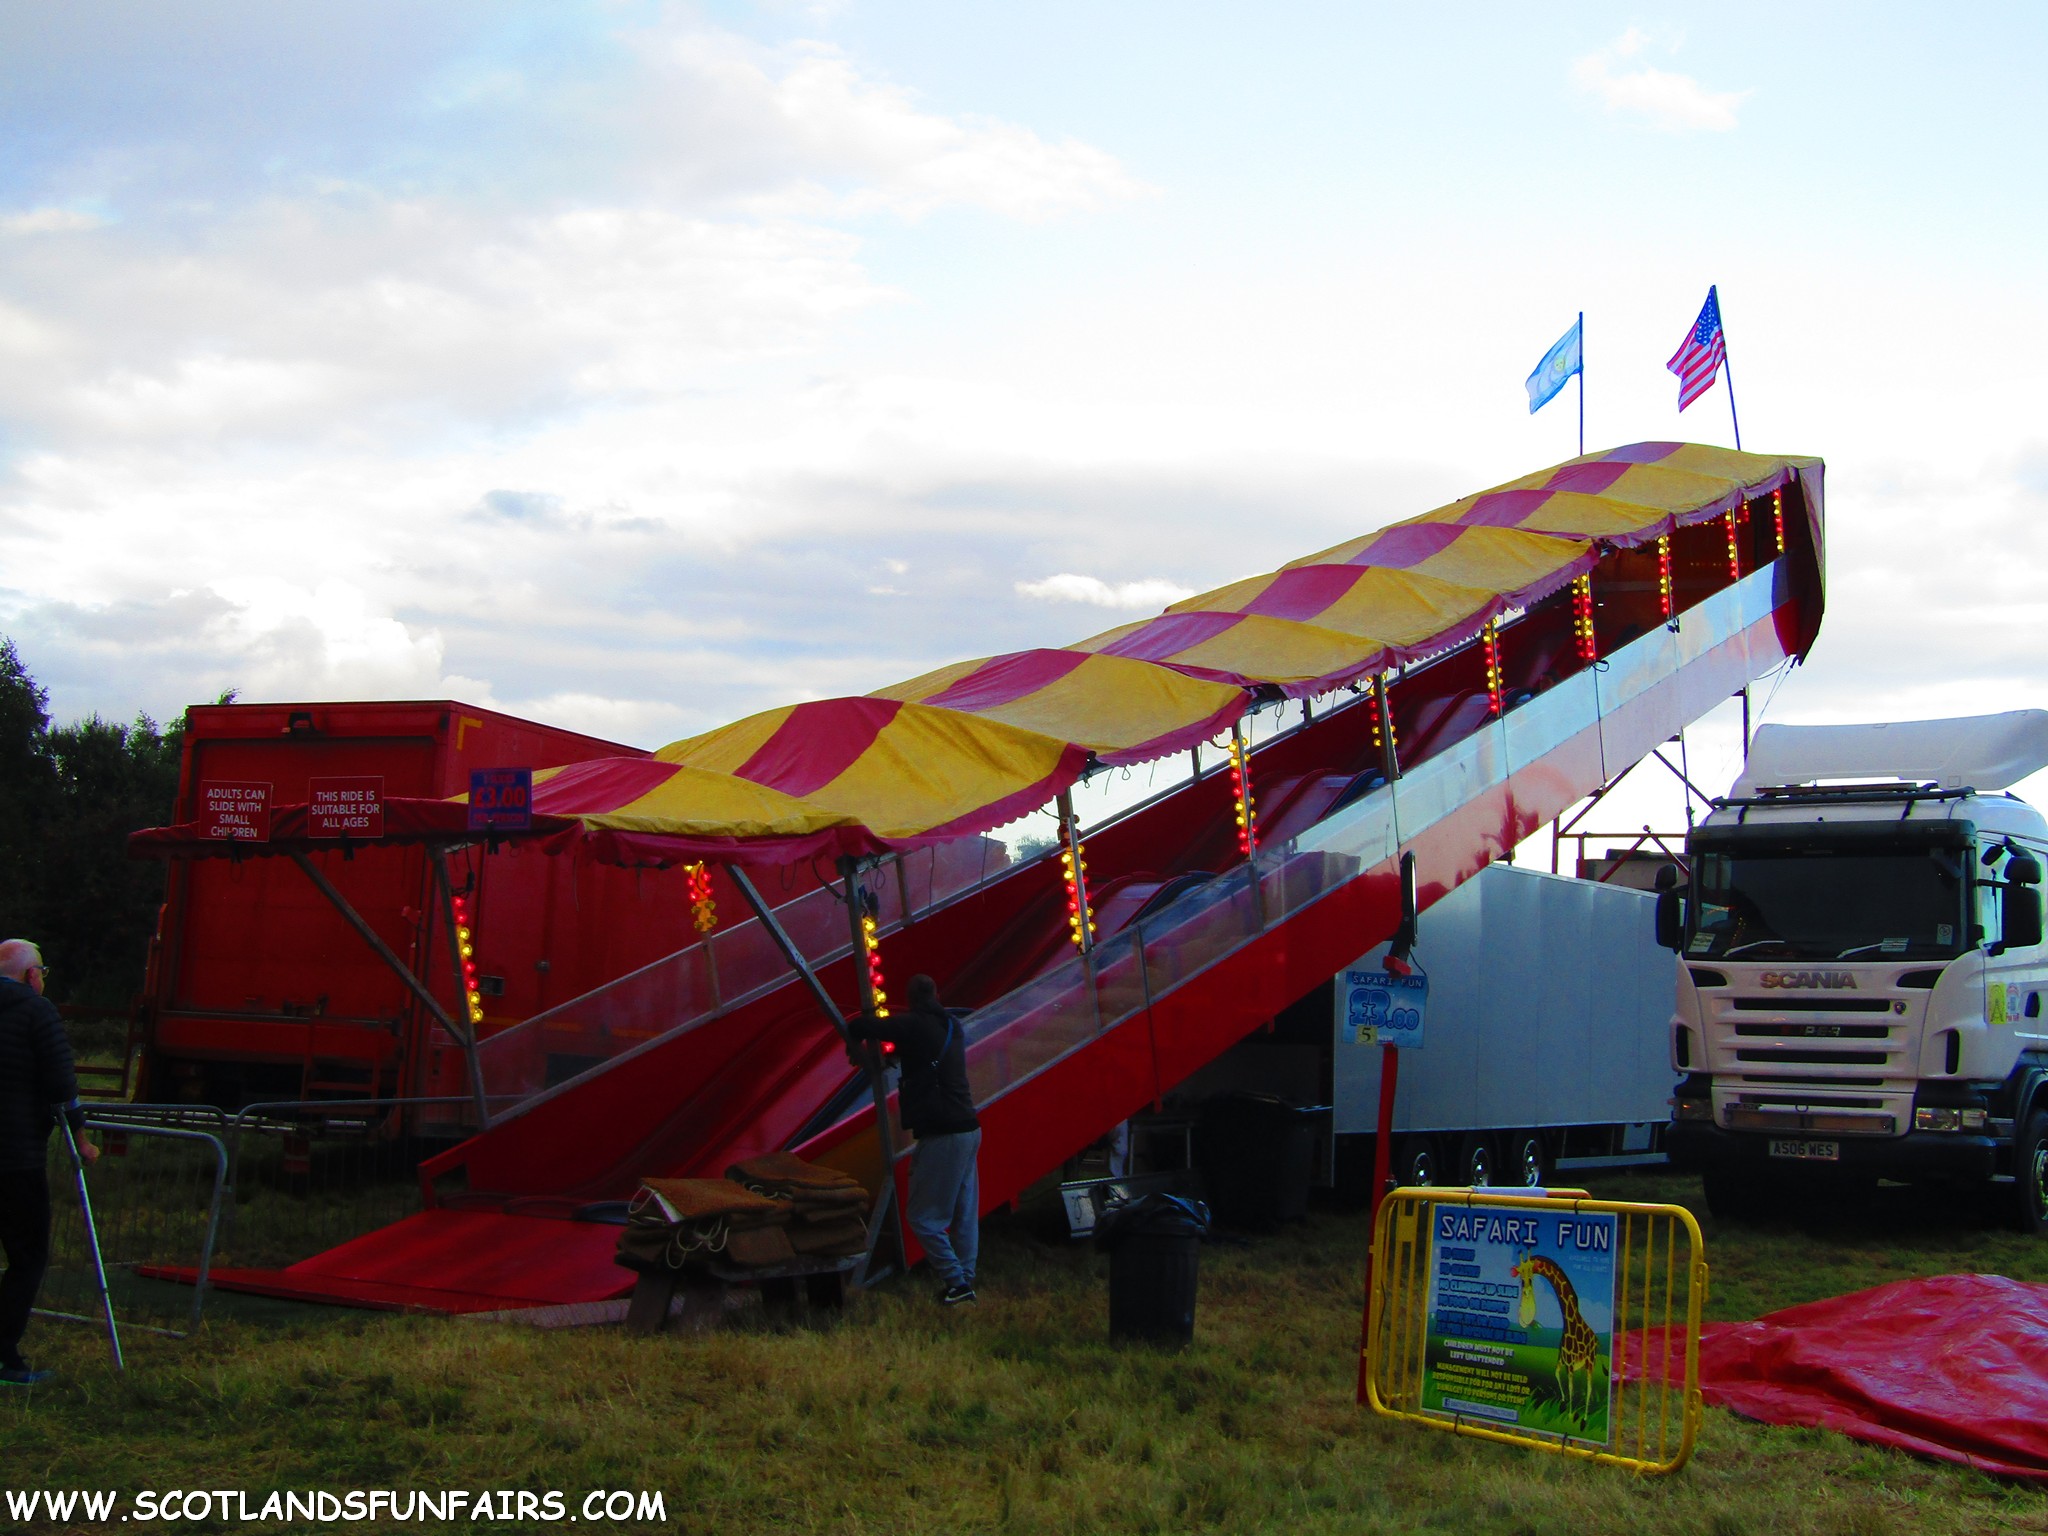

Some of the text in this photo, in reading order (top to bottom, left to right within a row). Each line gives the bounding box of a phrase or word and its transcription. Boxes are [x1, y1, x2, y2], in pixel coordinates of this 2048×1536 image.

[207, 788, 264, 800] ADULTS CAN
[317, 791, 374, 801] THIS RIDE IS
[474, 786, 526, 808] £3.00
[209, 801, 261, 812] SLIDE WITH
[312, 804, 379, 815] SUITABLE FOR
[220, 814, 250, 825] SMALL
[323, 817, 369, 828] ALL AGES
[1353, 976, 1422, 987] SAFARI FUN
[1760, 972, 1857, 989] SCANIA
[1349, 988, 1419, 1030] £3.00
[1362, 1028, 1371, 1042] 5
[1774, 1142, 1833, 1156] AS06 WES
[1441, 1215, 1608, 1249] SAFARI FUN
[1497, 1284, 1519, 1298] SLIDE
[1444, 1339, 1514, 1356] CHILDREN MUST NOT BE
[1450, 1350, 1505, 1366] LEFT UNATTENDED
[1437, 1362, 1528, 1384] MANAGEMENT WILL NOT BE HELD
[1432, 1372, 1468, 1384] RESPONSIBLE
[1470, 1378, 1480, 1386] FOR
[1494, 1382, 1505, 1390] ANY
[1506, 1384, 1520, 1393] LOSS
[1521, 1387, 1530, 1395] OR
